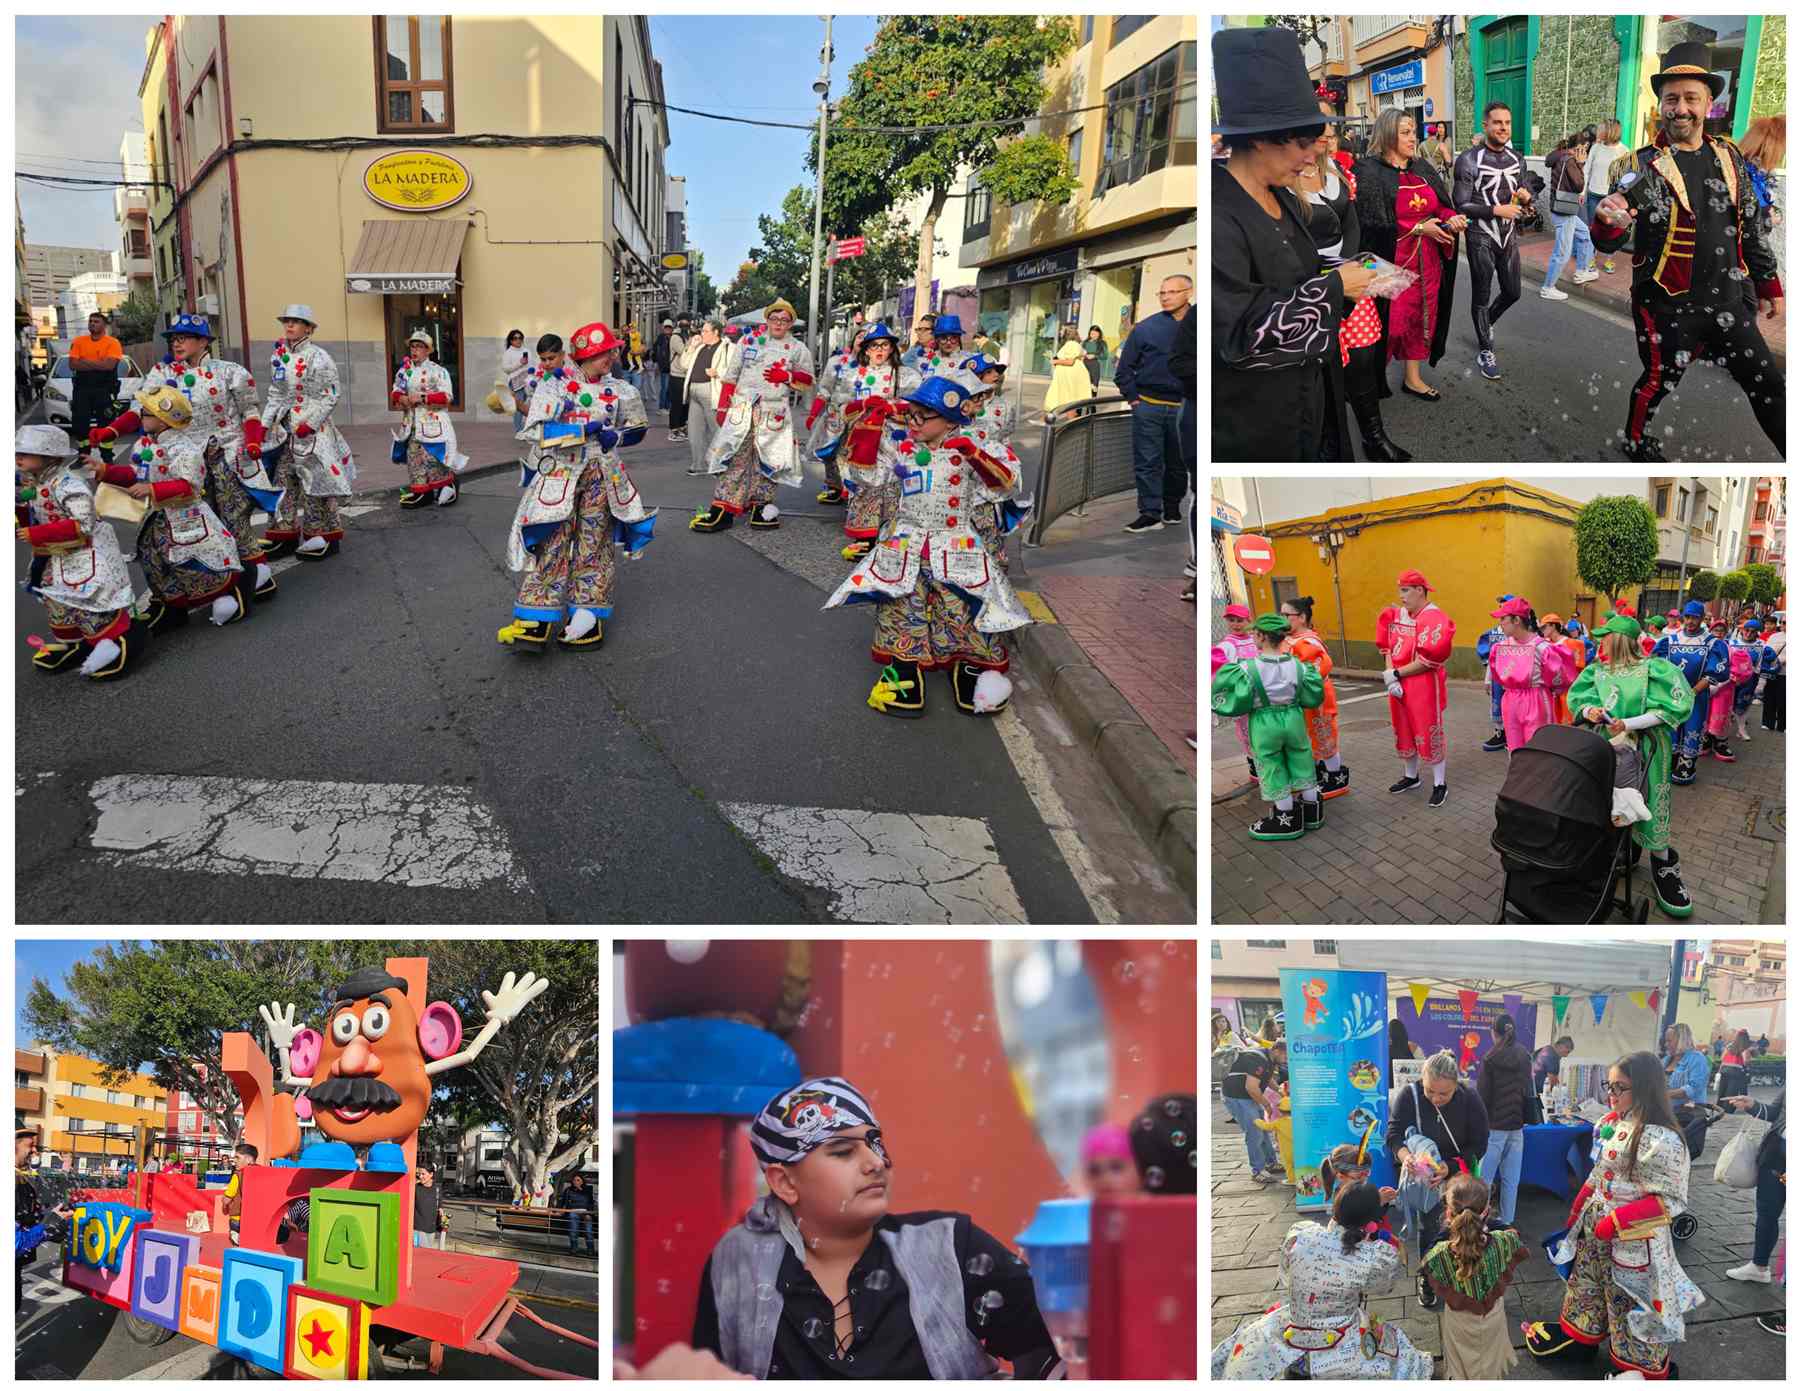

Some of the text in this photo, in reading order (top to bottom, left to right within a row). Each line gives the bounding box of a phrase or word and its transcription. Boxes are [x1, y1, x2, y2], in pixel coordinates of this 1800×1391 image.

[374, 173, 392, 185] LA
[382, 280, 451, 290] LA MADERA
[71, 1207, 132, 1266] TOY
[324, 1214, 369, 1270] A
[144, 1255, 272, 1339] J M D
